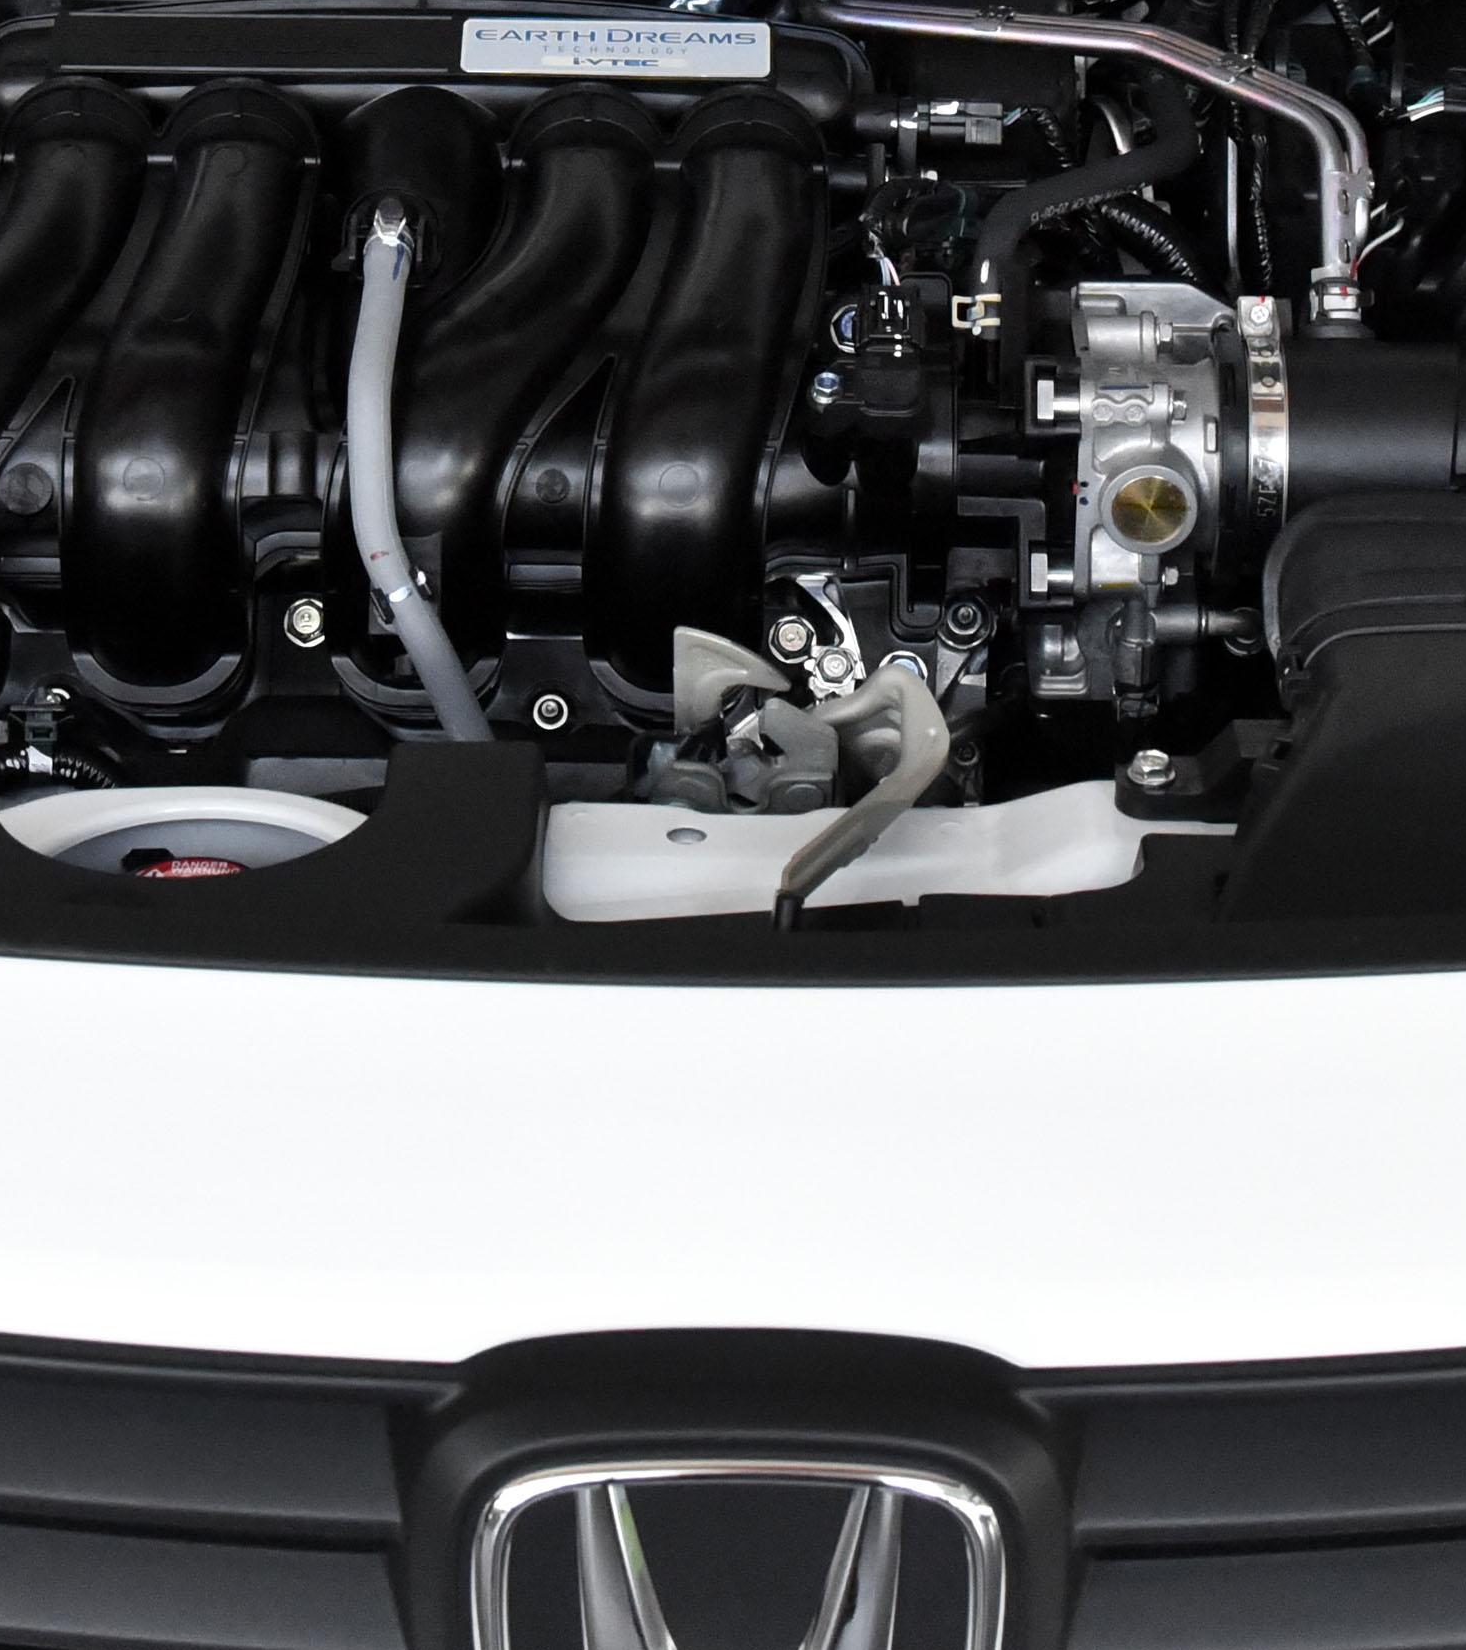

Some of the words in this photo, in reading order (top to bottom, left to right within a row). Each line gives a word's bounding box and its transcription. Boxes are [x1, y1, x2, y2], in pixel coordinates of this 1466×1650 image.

[475, 29, 596, 43] EARTH
[606, 29, 757, 45] DREAMS
[542, 45, 688, 55] TECHNOLOGY
[573, 57, 660, 67] i-VTEC
